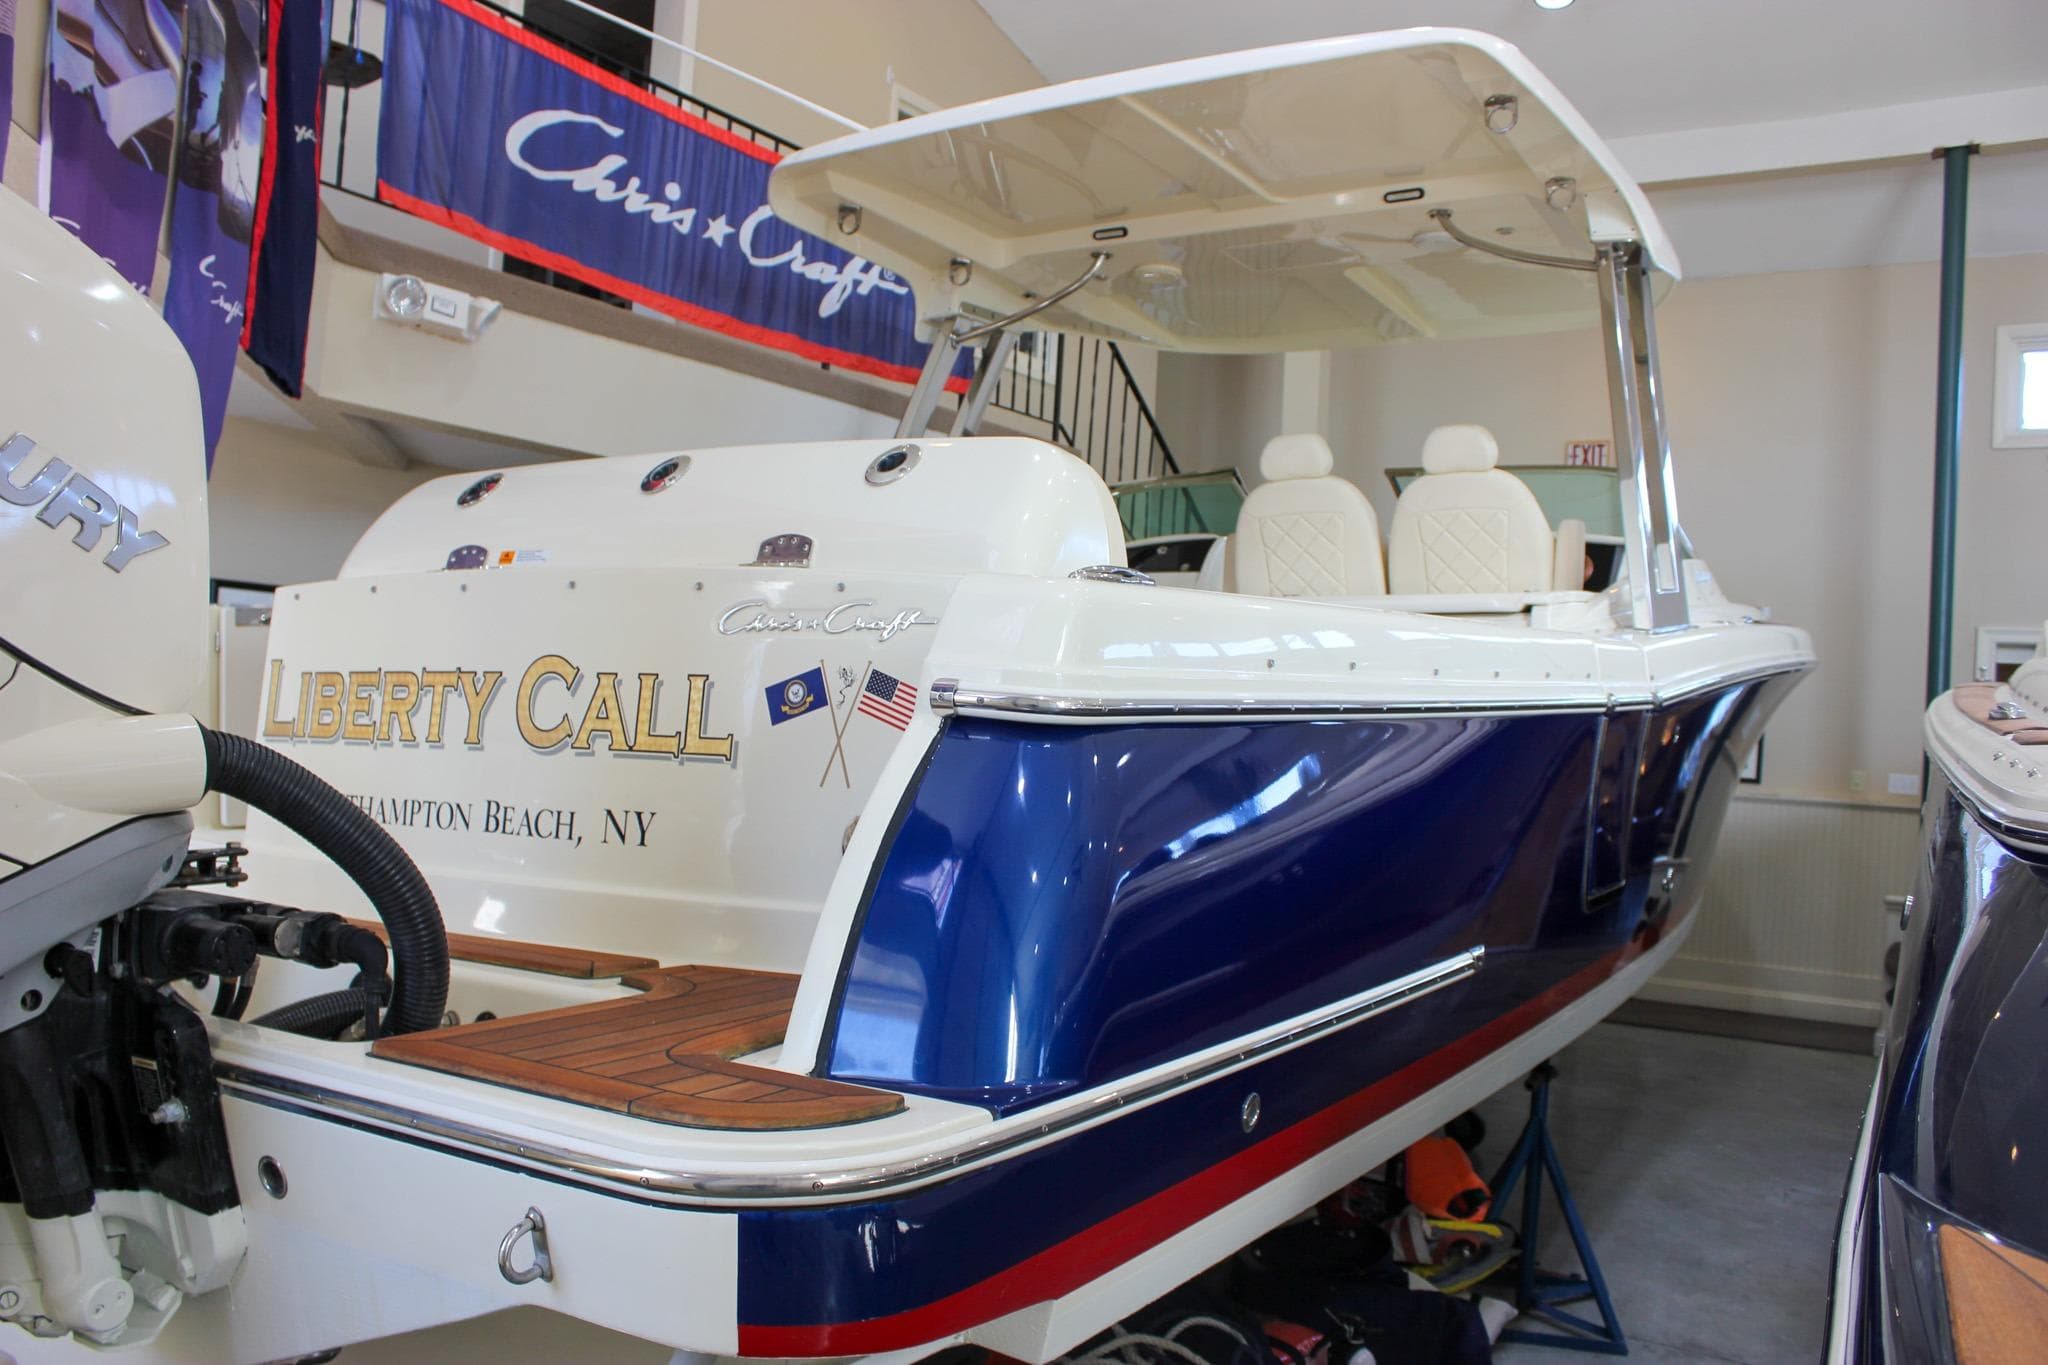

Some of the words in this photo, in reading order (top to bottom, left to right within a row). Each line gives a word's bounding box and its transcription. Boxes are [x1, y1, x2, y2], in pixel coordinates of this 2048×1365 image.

[505, 109, 697, 234] Chris
[1572, 443, 1605, 466] EXIT
[263, 658, 505, 748] LIBERTY
[516, 654, 737, 765] CALL
[483, 800, 583, 849] BEACH,
[601, 808, 656, 847] NY
